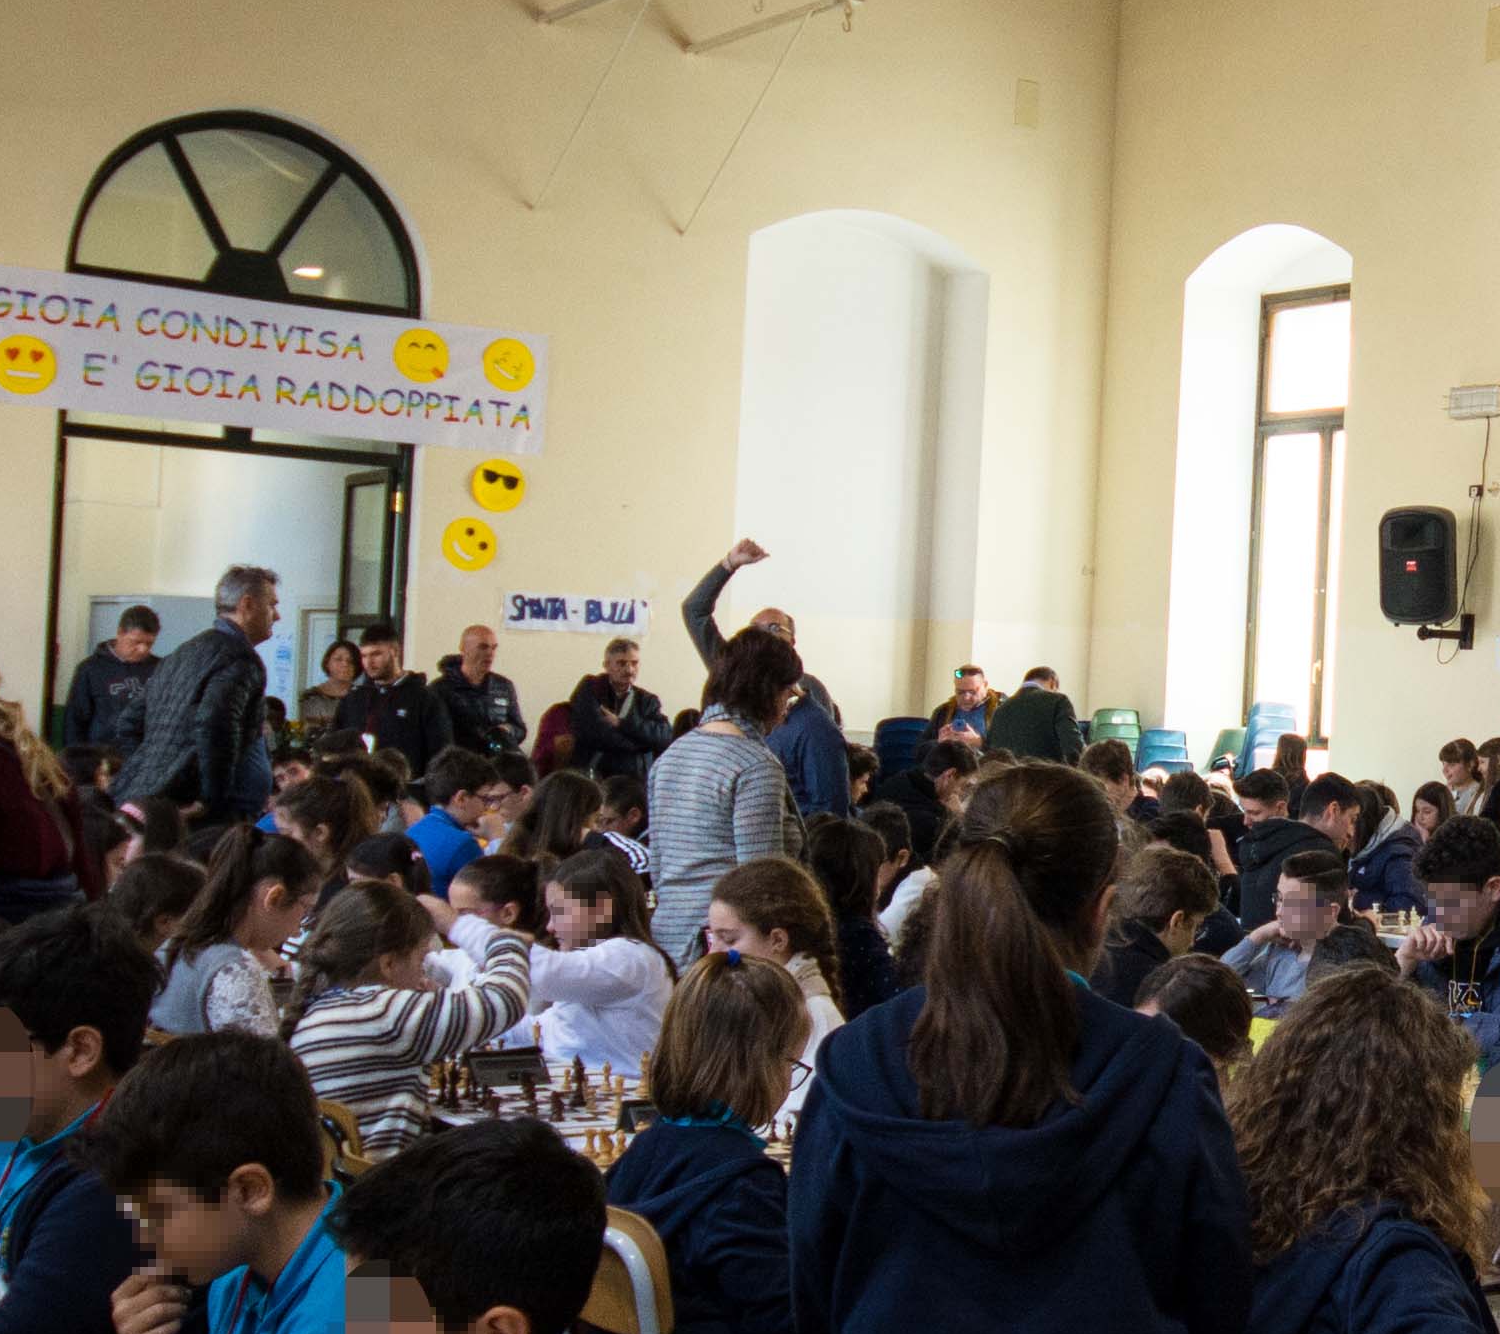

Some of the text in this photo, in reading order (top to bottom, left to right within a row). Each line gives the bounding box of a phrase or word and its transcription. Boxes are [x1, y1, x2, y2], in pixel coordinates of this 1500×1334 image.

[136, 308, 364, 361] CONDIVISA
[83, 353, 531, 430] E' GIOIA RADDOPPIATA
